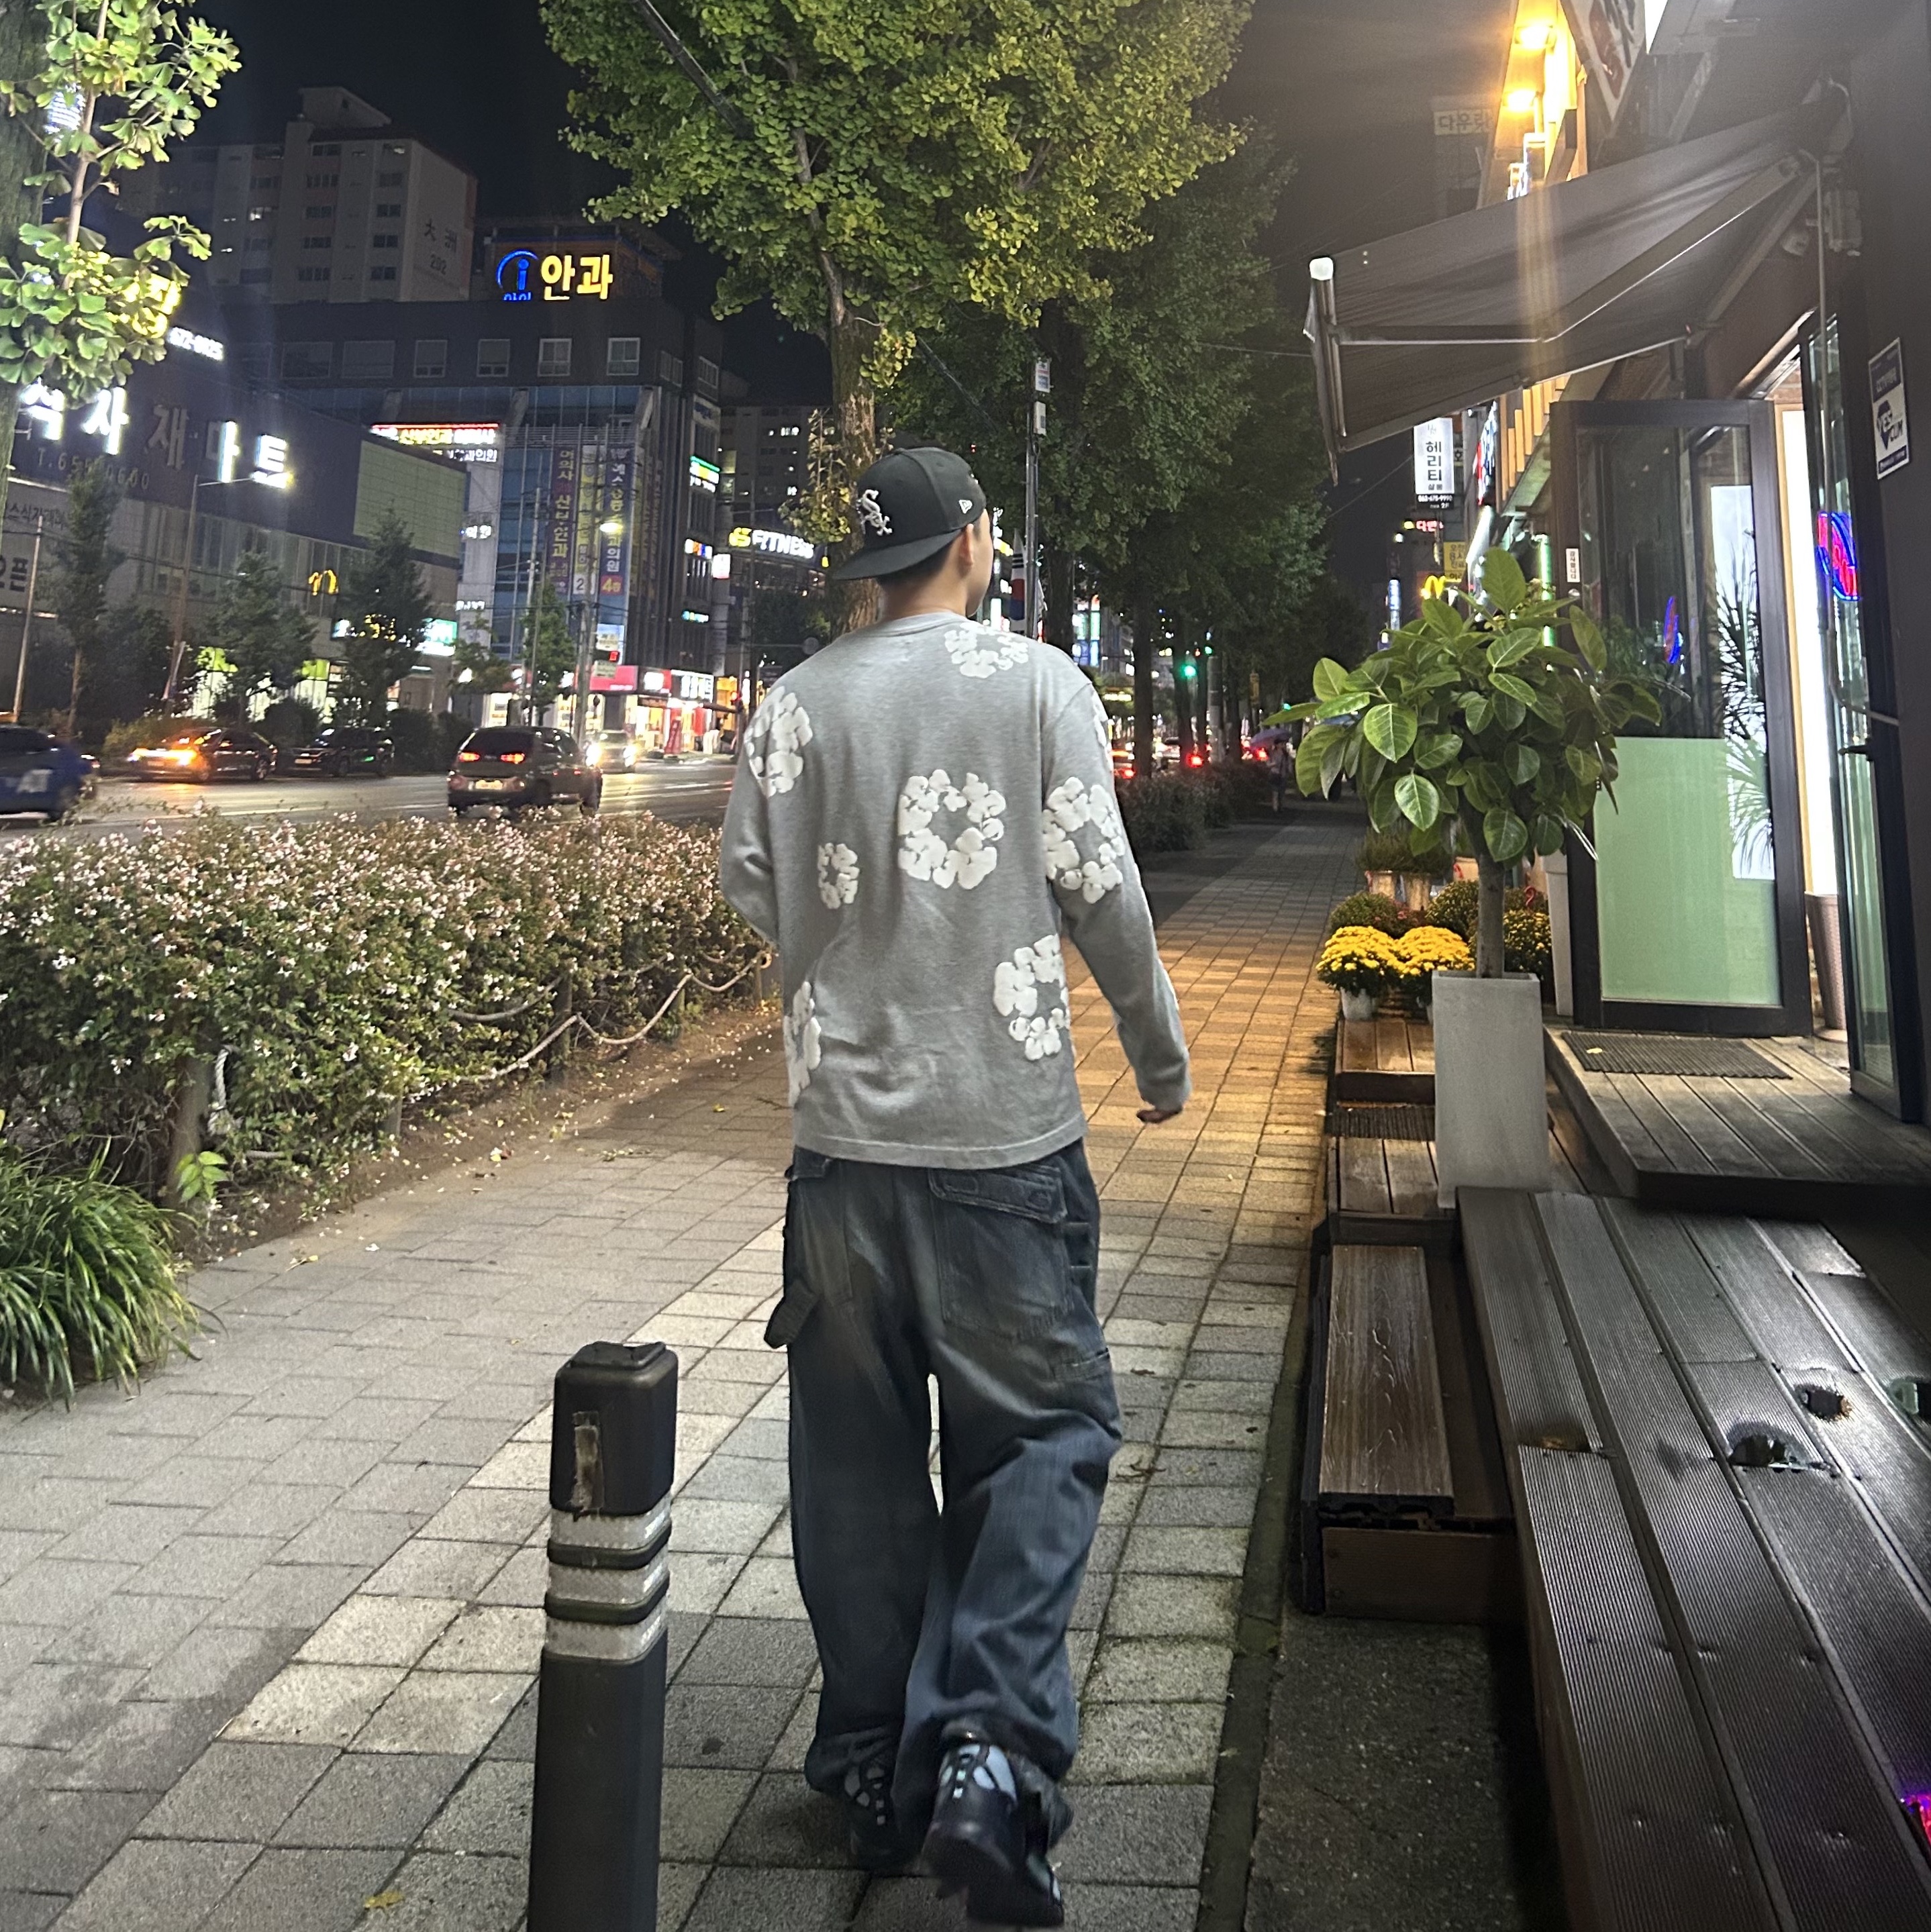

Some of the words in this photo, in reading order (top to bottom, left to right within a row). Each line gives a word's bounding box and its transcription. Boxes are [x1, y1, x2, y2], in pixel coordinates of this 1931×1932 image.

[541, 254, 613, 301] 안과
[1426, 441, 1442, 481] 헤리티
[752, 529, 814, 559] FITNESS
